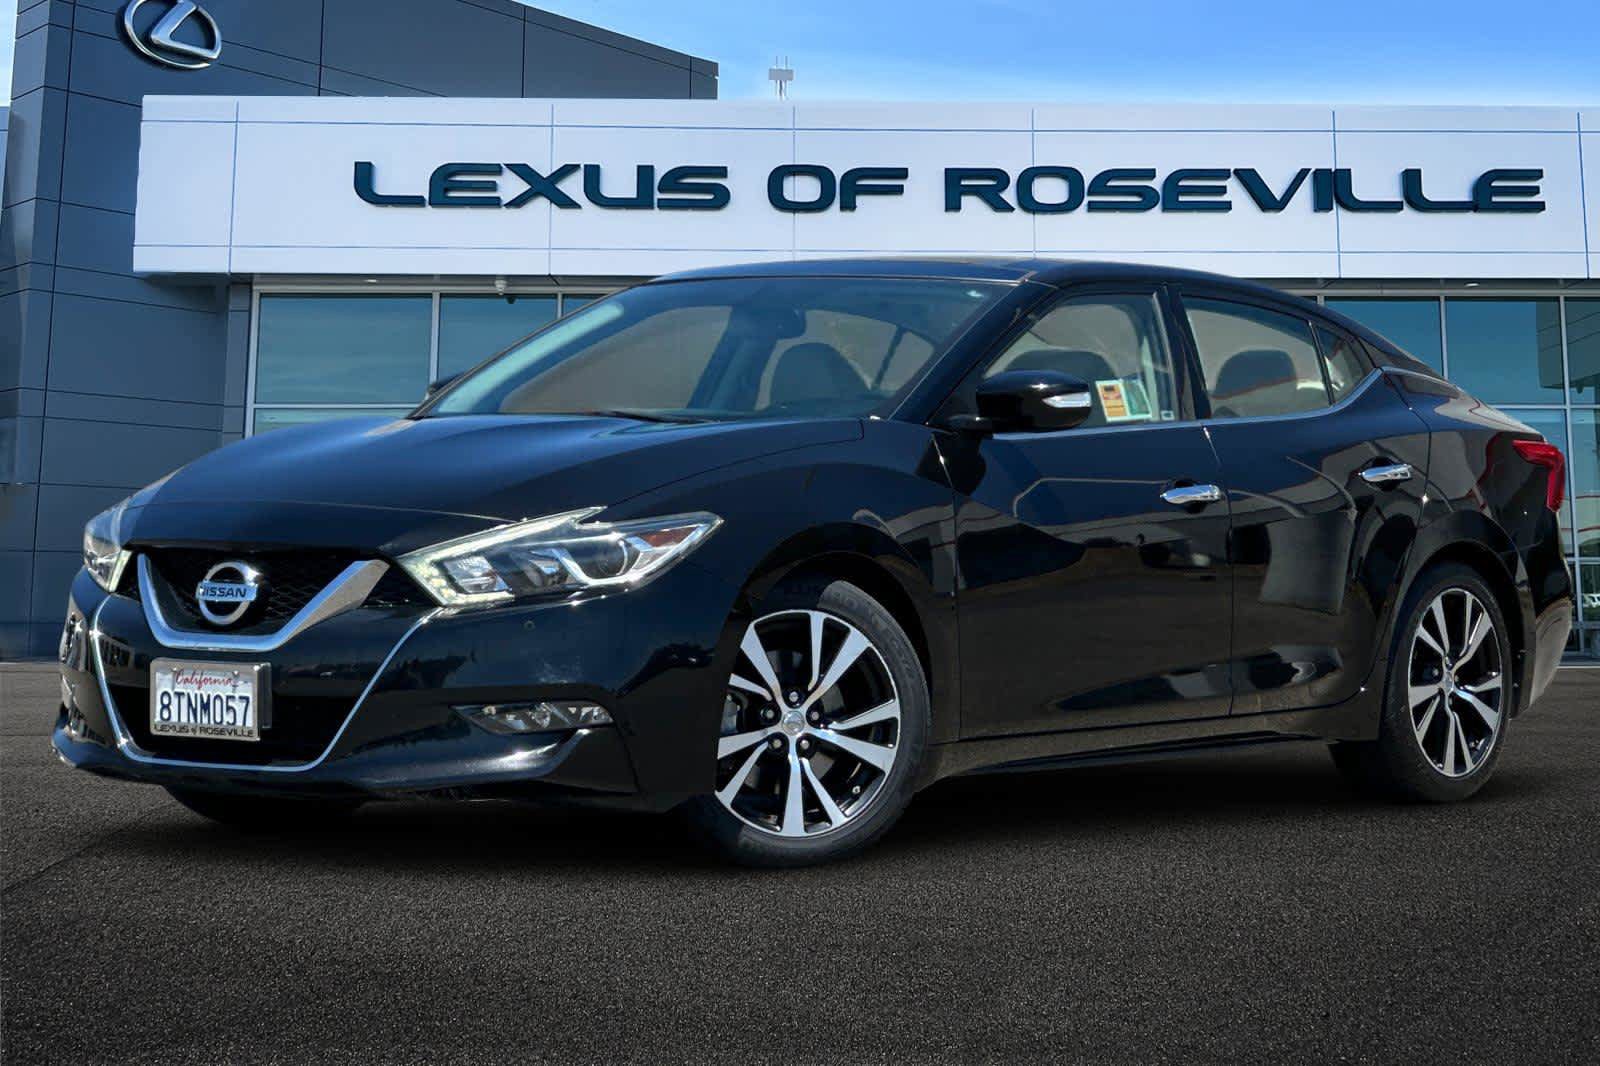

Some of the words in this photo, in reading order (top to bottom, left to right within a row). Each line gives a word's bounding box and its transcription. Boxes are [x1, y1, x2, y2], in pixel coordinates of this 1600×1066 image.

[354, 161, 731, 210] LEXUS
[767, 164, 909, 213] OF
[944, 165, 1546, 213] ROSEVILLE
[175, 669, 233, 690] California
[160, 691, 250, 727] 8TNM057
[153, 724, 189, 733] LEXUS
[199, 727, 255, 738] ROSEVILLE
